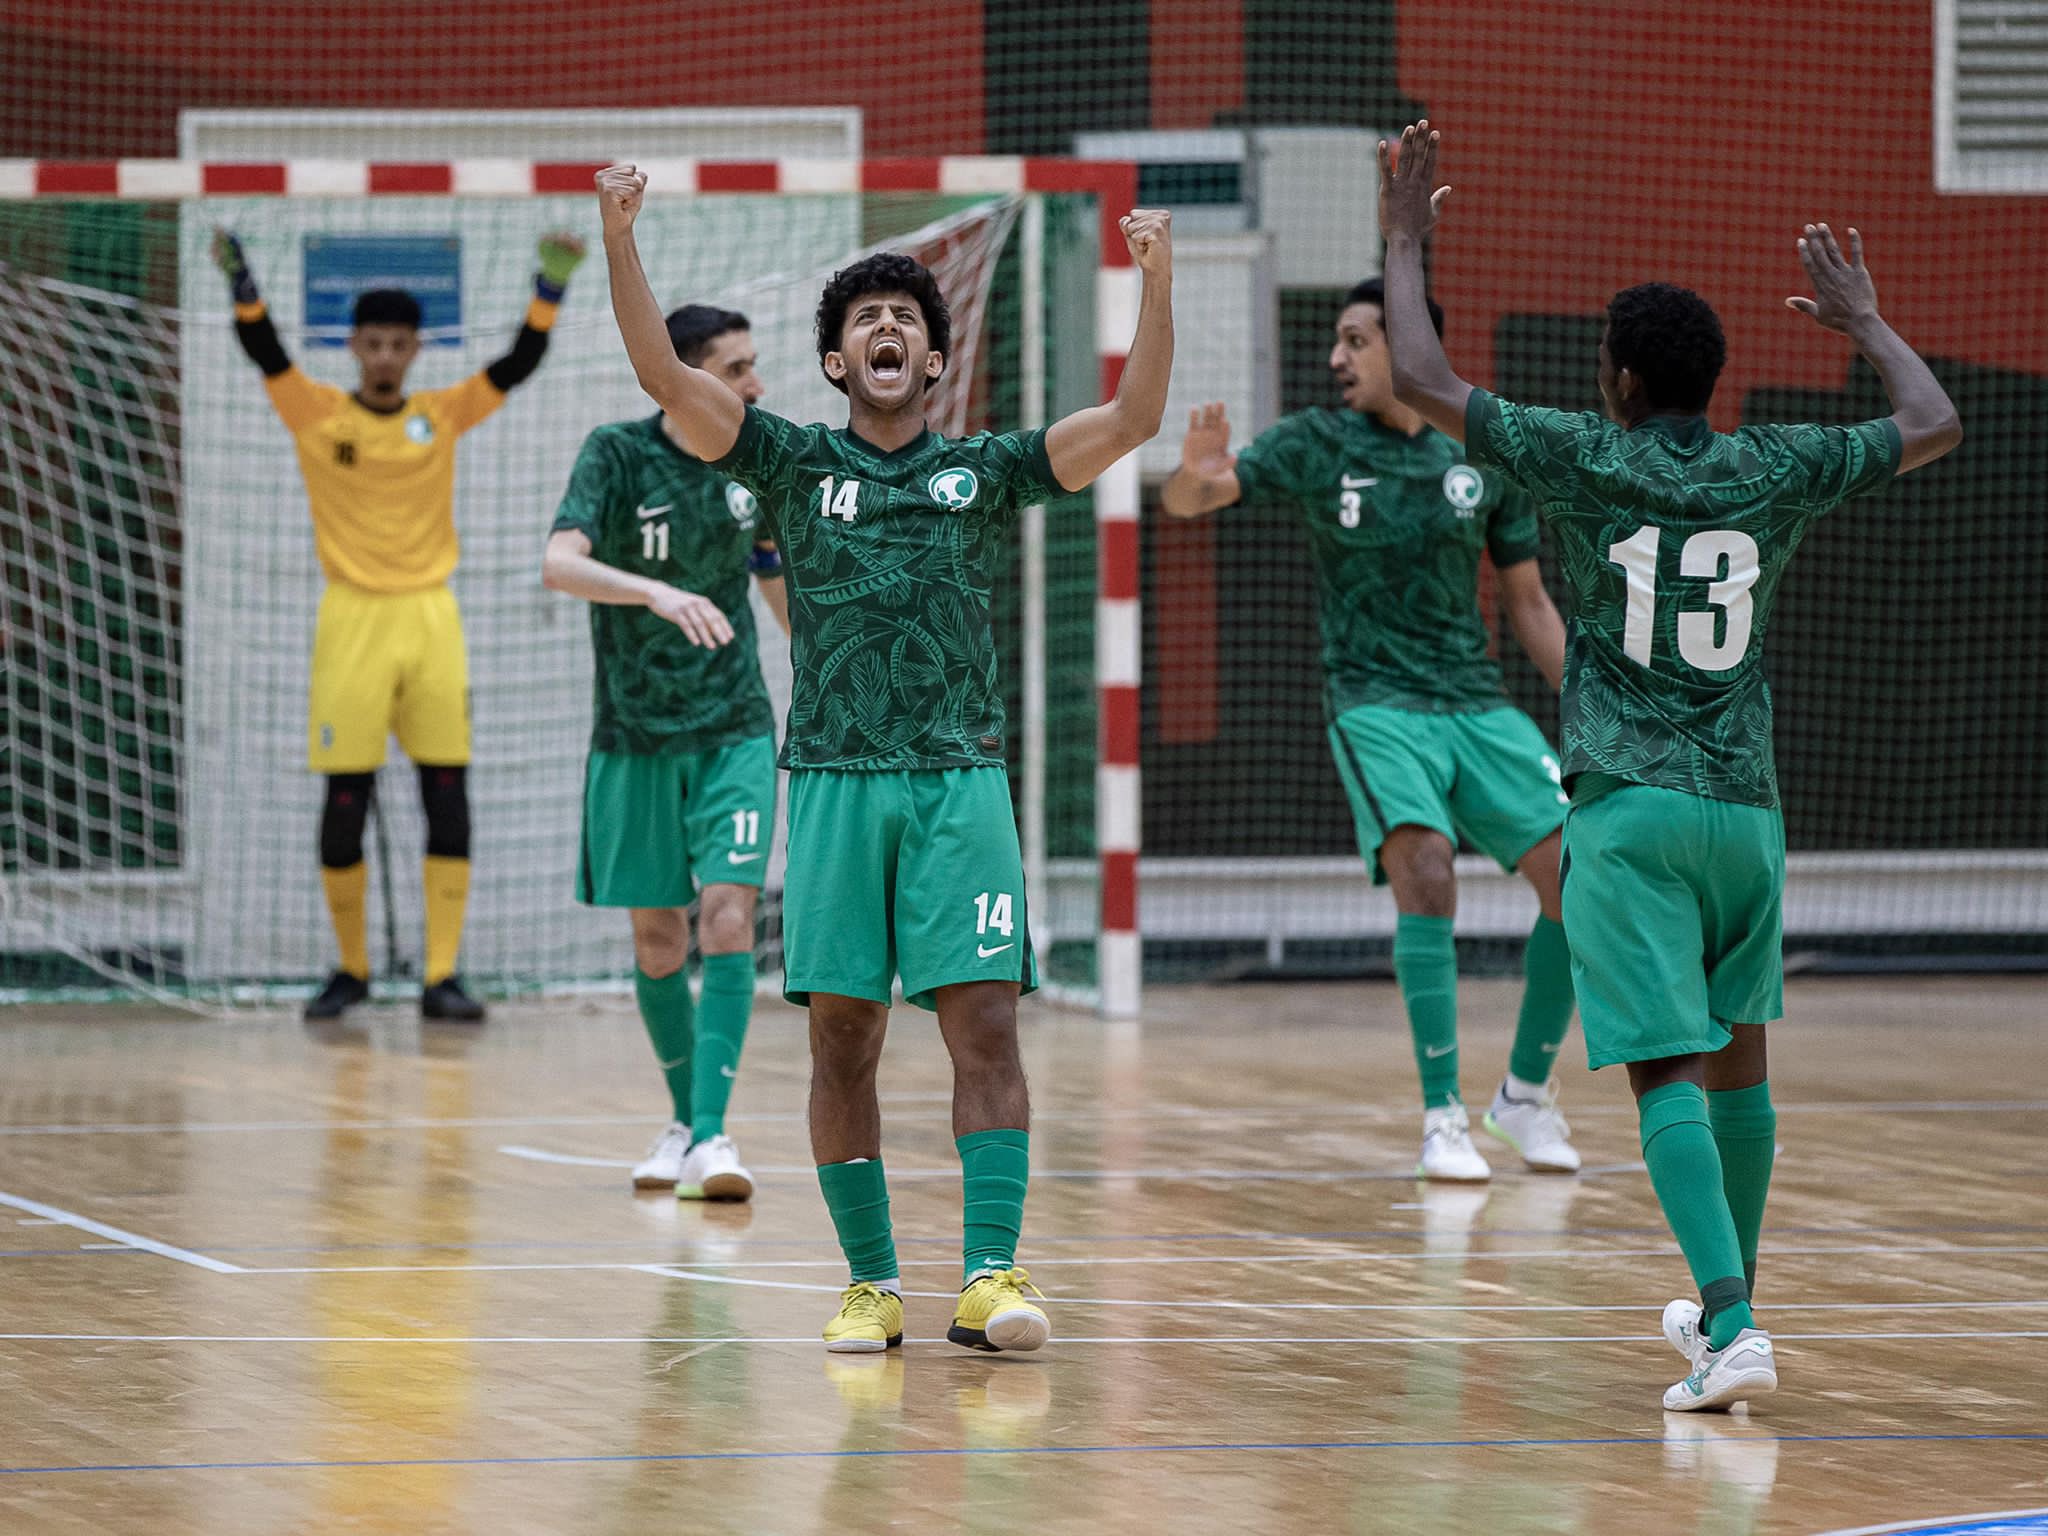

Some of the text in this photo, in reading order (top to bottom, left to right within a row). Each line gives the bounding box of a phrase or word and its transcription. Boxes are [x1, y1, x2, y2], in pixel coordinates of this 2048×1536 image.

[818, 475, 860, 522] 14
[1339, 491, 1361, 528] 3
[640, 521, 669, 561] 11
[1609, 525, 1761, 672] 13
[731, 809, 759, 845] 11
[974, 892, 1014, 937] 14
